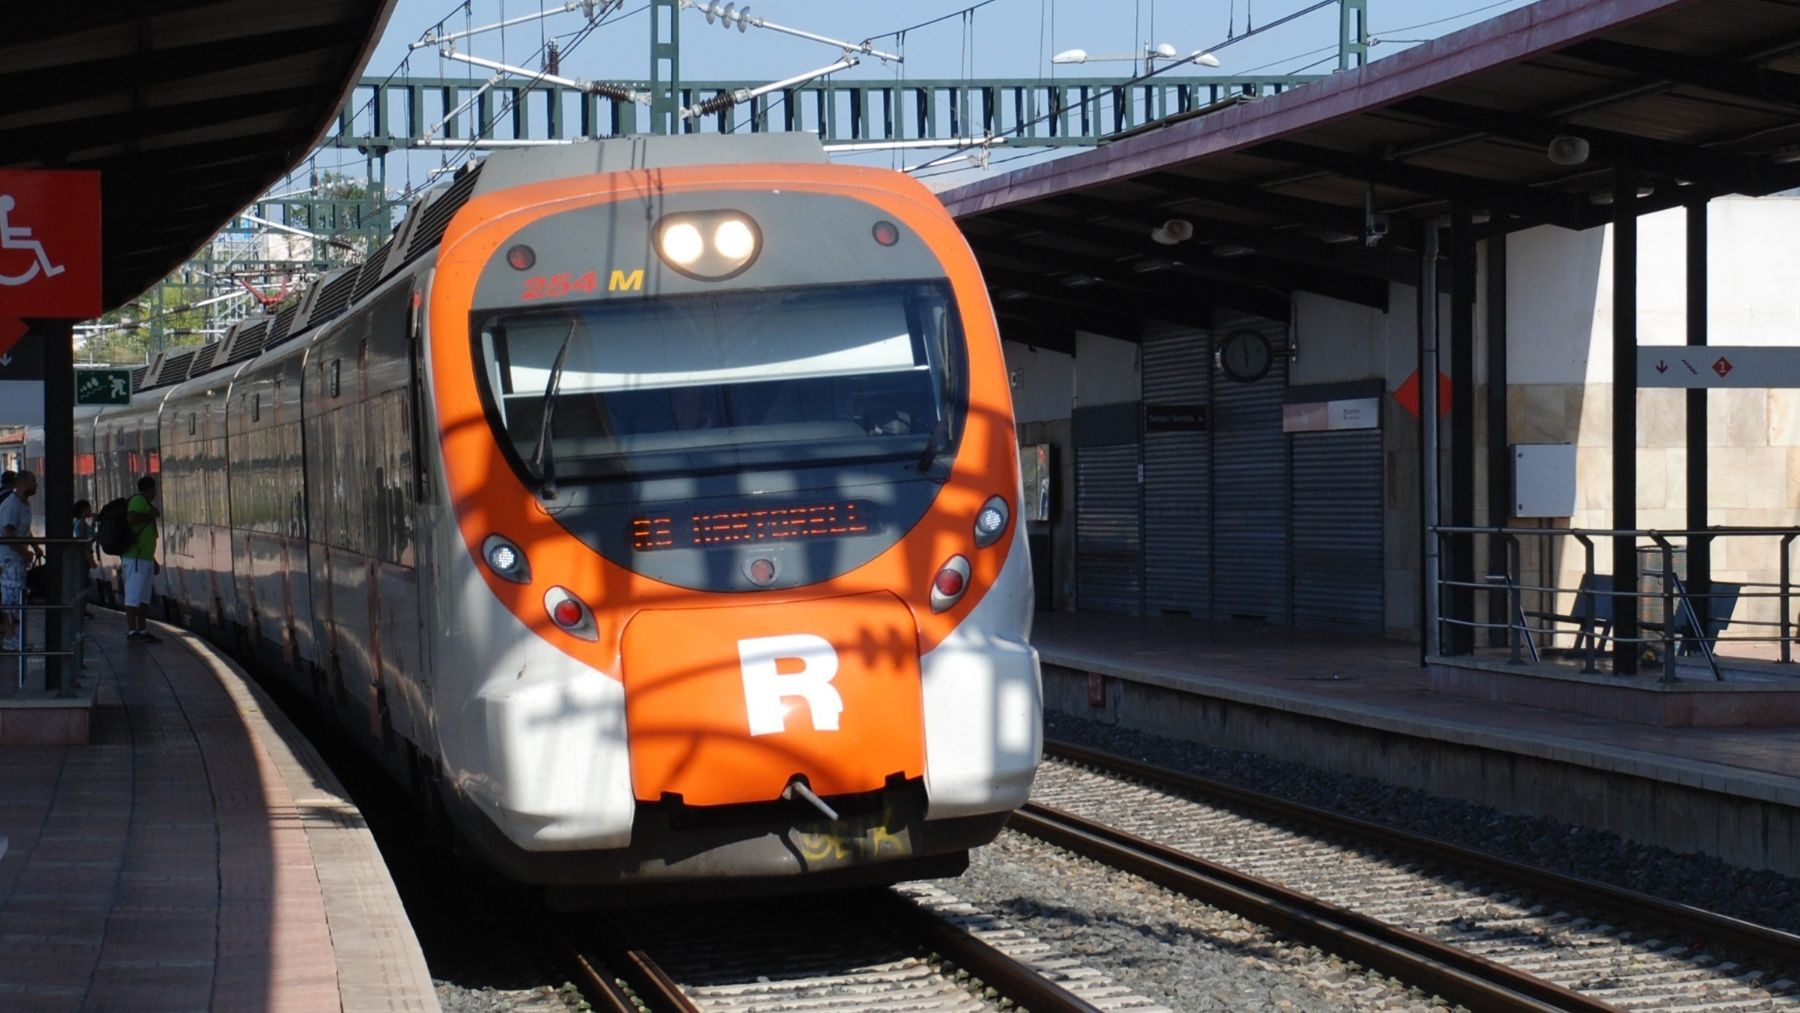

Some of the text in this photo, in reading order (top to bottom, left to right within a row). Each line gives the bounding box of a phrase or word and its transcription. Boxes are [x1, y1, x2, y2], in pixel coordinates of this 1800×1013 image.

[522, 270, 644, 301] 254 M
[737, 633, 844, 737] R
